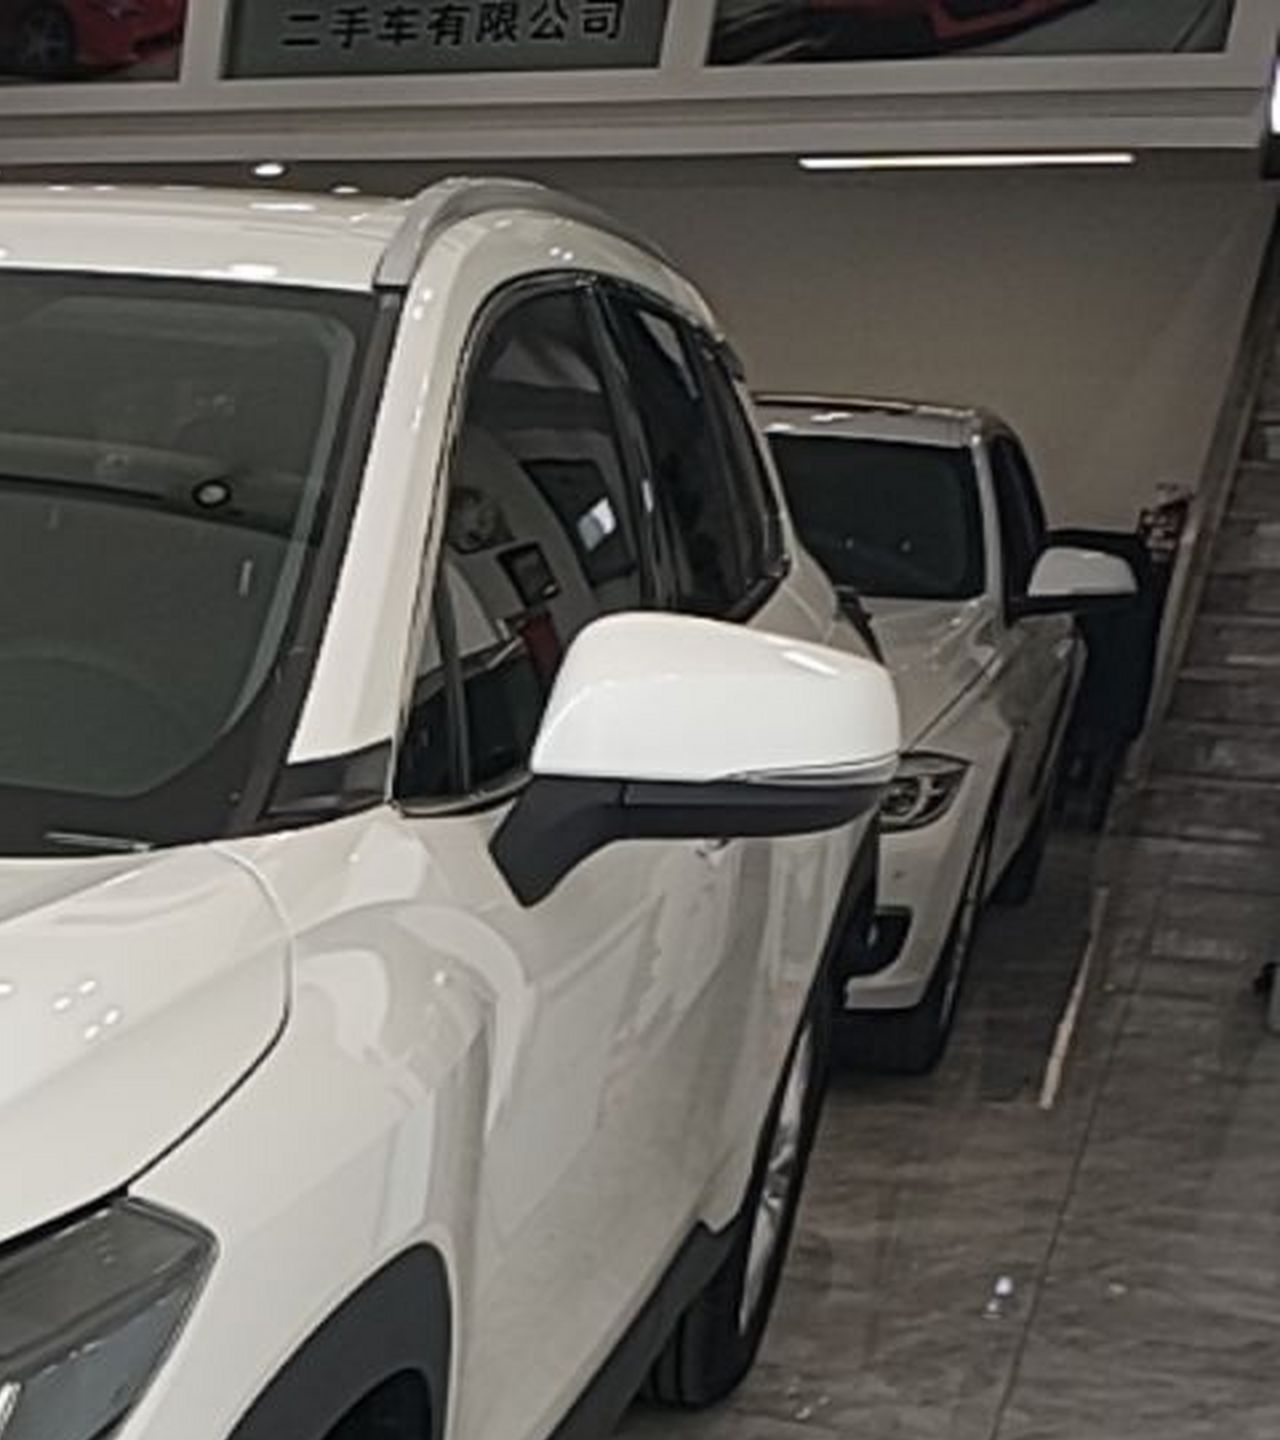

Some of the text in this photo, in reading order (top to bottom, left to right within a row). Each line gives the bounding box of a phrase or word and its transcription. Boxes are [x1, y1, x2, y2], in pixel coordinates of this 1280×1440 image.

[281, 0, 622, 49] 二手车有限公司
